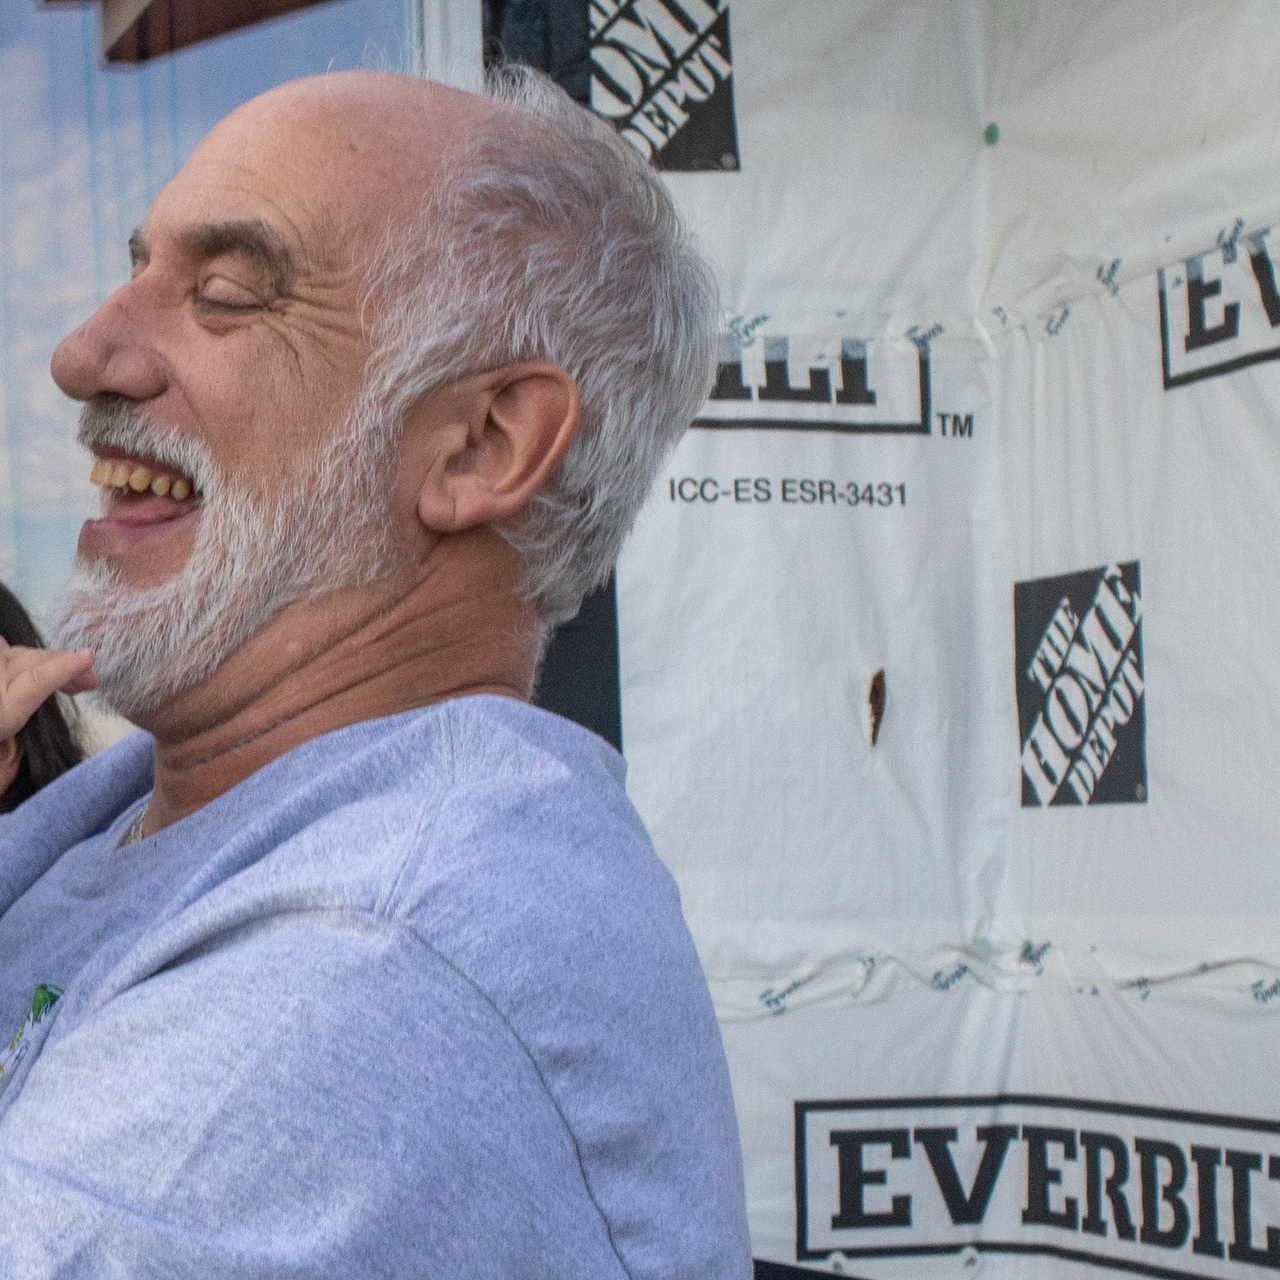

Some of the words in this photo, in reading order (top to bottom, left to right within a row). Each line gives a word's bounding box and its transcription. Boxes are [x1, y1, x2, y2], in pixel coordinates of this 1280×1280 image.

[937, 412, 974, 437] TM
[669, 477, 771, 503] ICC-ES
[781, 478, 907, 507] ESR-3431
[1021, 565, 1143, 807] HOME
[1026, 595, 1080, 694] THE
[1069, 649, 1145, 807] DEPOT
[830, 1124, 1280, 1269] EVERBIL
